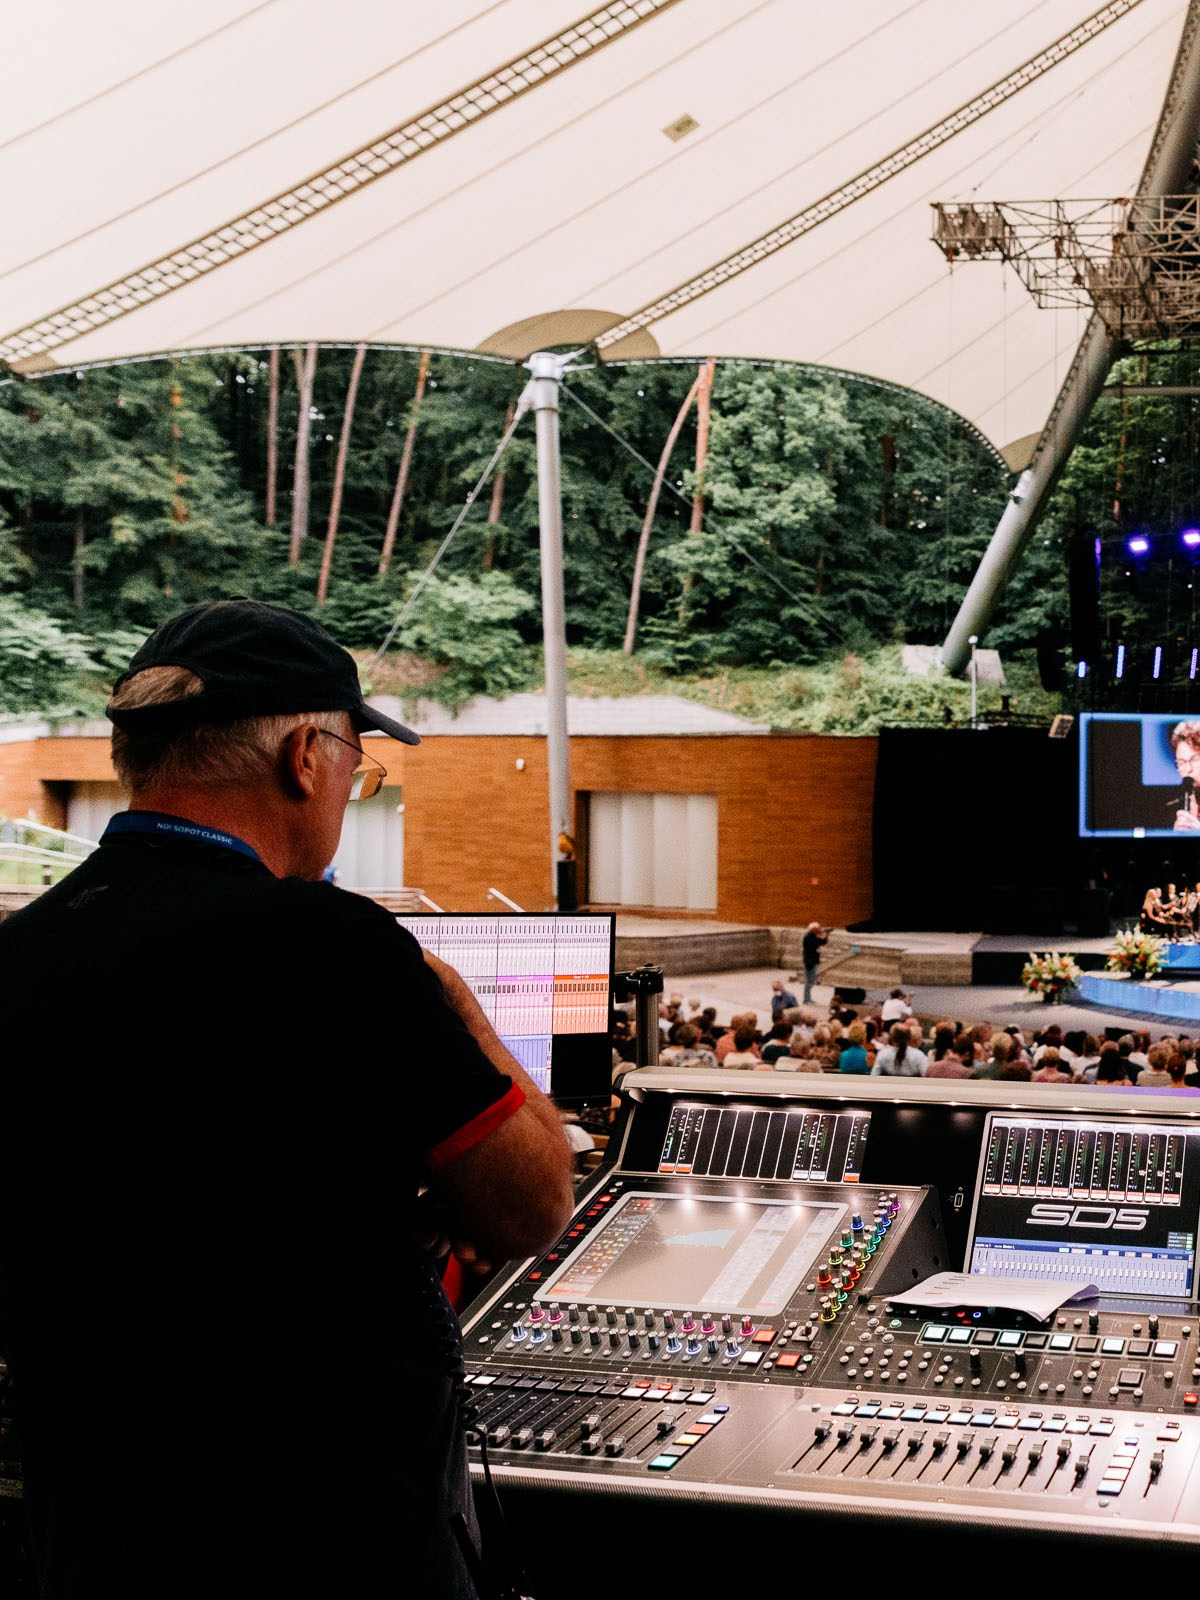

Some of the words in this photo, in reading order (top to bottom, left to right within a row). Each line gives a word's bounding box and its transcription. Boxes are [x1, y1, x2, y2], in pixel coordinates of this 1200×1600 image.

[173, 825, 200, 836] SOPOT
[201, 831, 233, 845] CLASSIC
[1026, 1203, 1150, 1231] SD5
